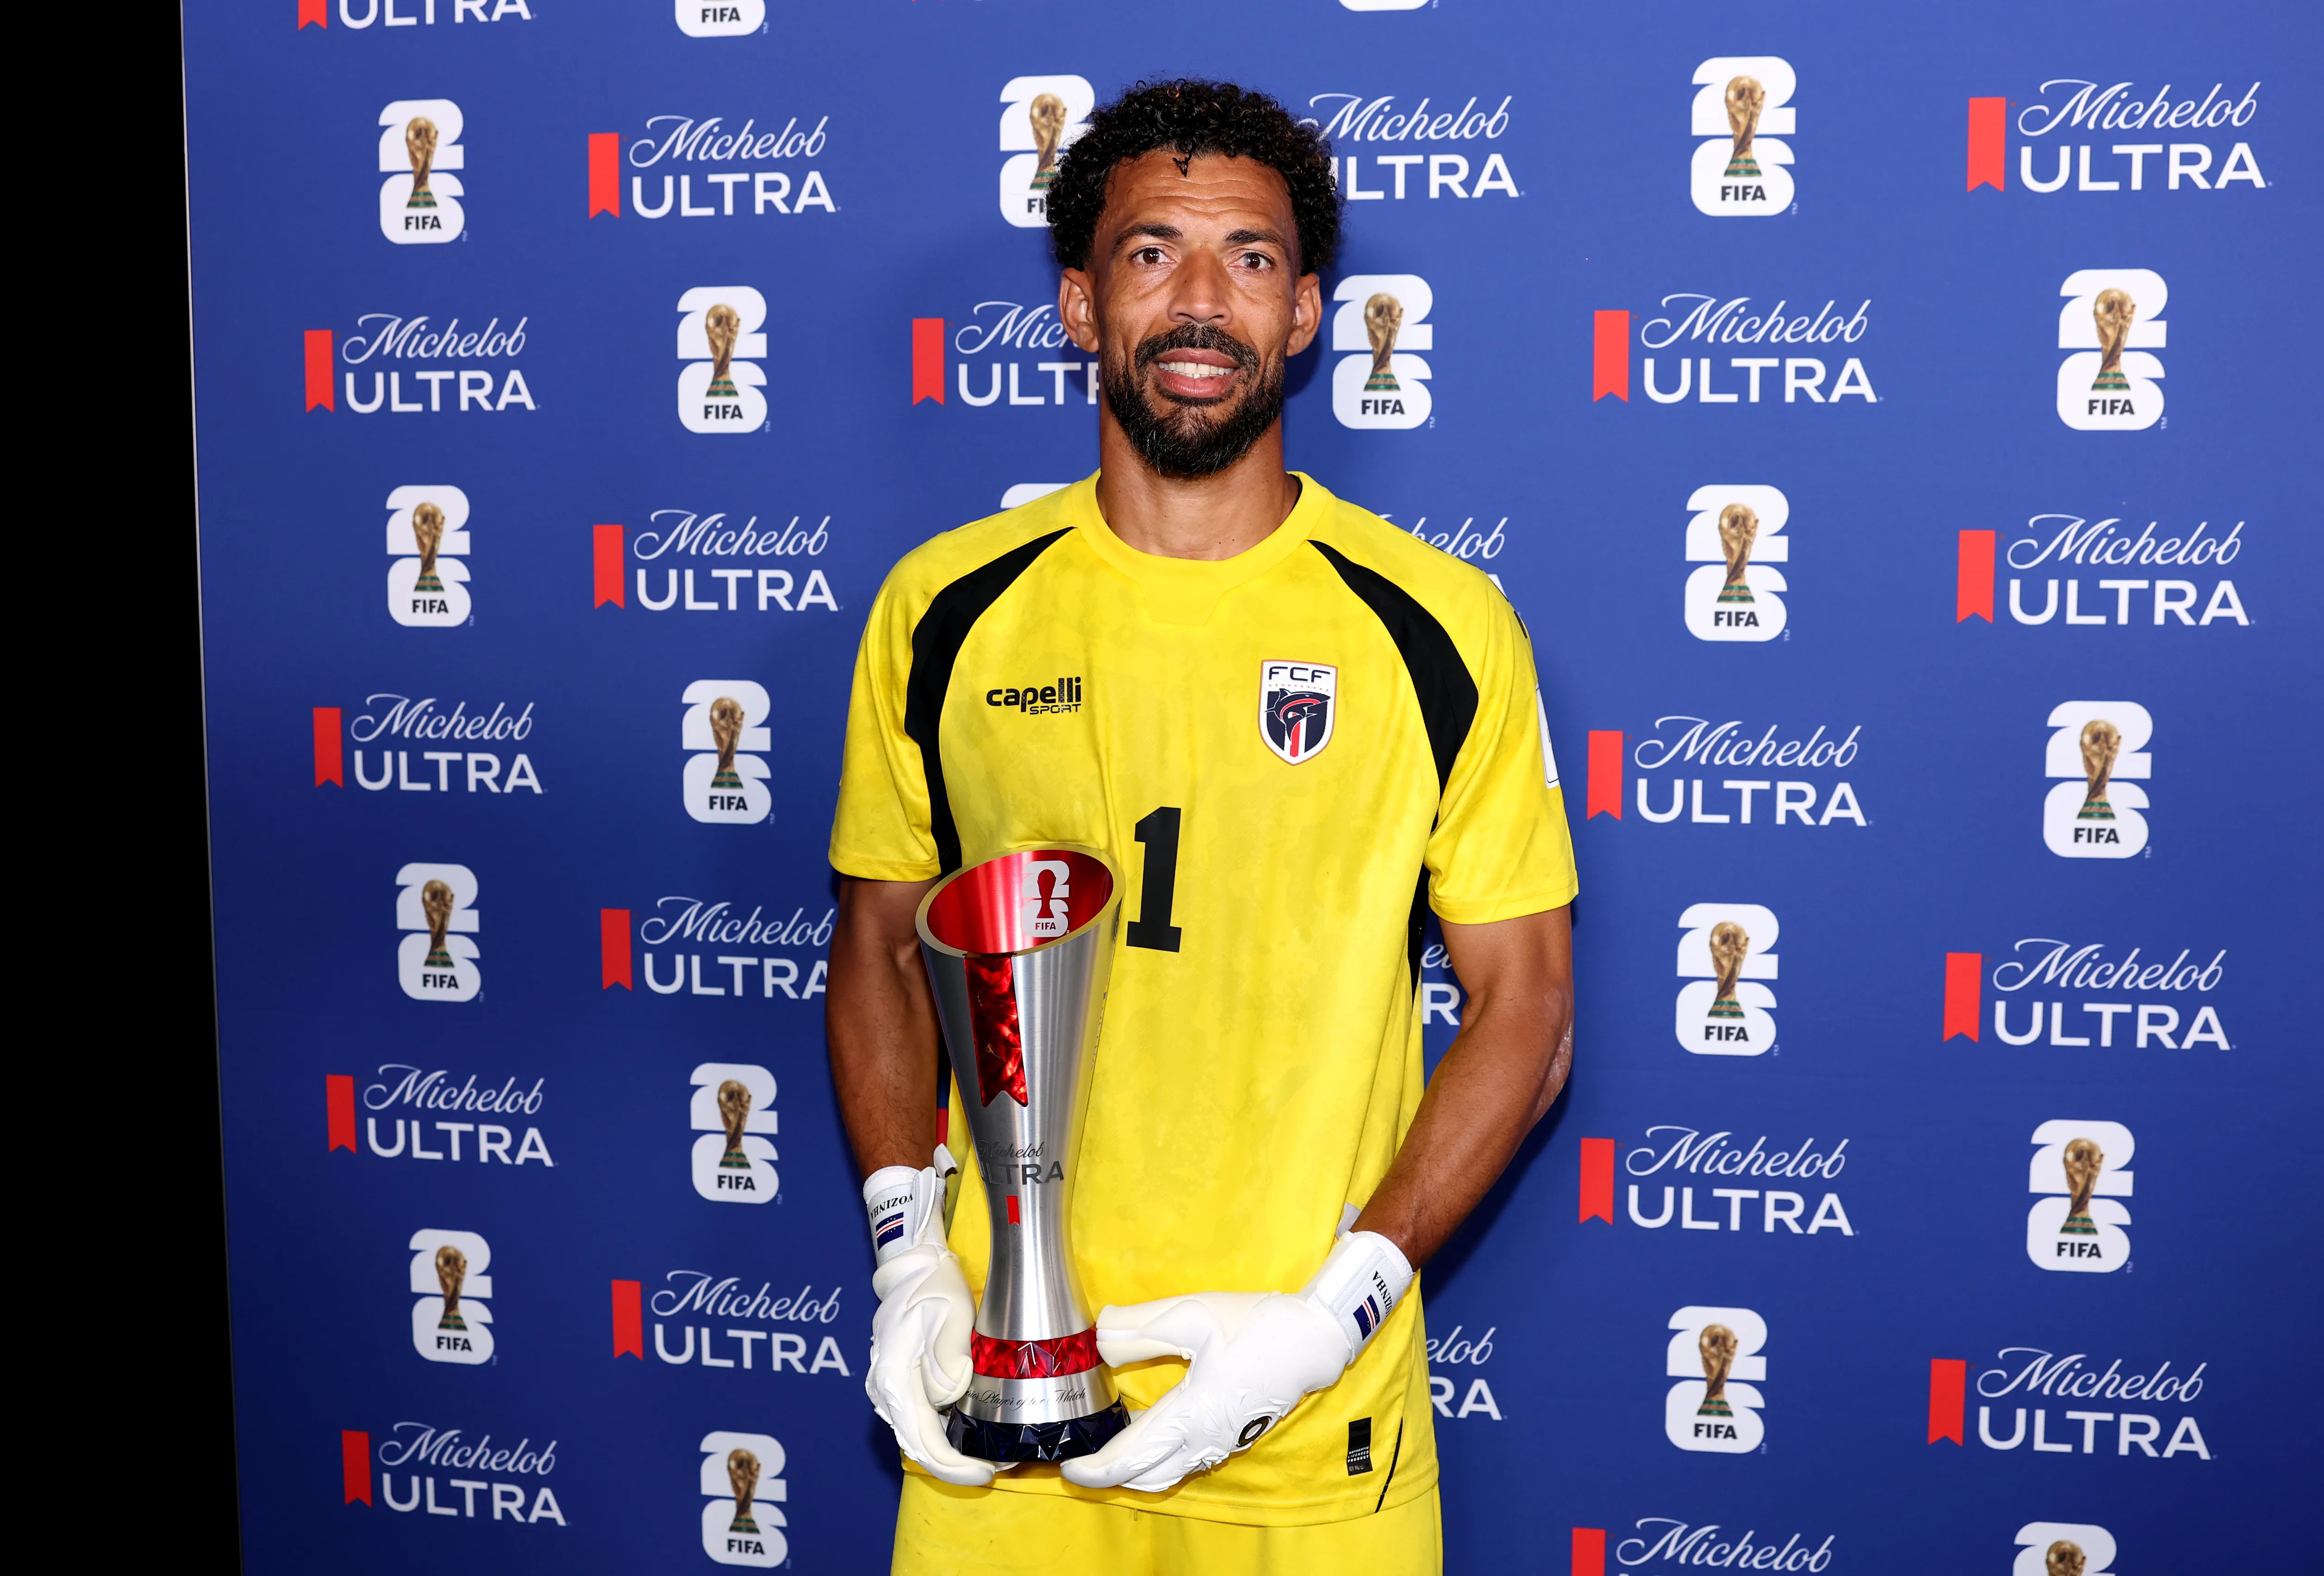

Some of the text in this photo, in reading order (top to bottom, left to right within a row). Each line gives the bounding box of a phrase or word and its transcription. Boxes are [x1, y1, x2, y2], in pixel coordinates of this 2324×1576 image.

[702, 7, 740, 23] FIFA
[1297, 93, 1512, 142] Michelob
[2018, 80, 2260, 136] Michelob
[629, 116, 828, 168] Michelob
[1329, 154, 1519, 200] LTRA
[2021, 143, 2266, 192] ULTRA
[633, 171, 836, 218] ULTRA
[1028, 198, 1044, 213] FI
[1721, 185, 1766, 201] FIFA
[405, 216, 441, 230] FIFA
[343, 314, 528, 364] Michelob
[1641, 294, 1870, 348] Michelob
[346, 370, 535, 413] ULTRA
[1644, 358, 1877, 403] ULTRA
[704, 405, 743, 419] FIFA
[1361, 399, 1405, 416] FIFA
[2088, 399, 2135, 415] FIFA
[634, 510, 830, 559] Michelob
[2007, 514, 2244, 569] Michelob
[412, 599, 448, 613] FIFA
[637, 569, 838, 611] ULTRA
[2009, 579, 2249, 626] ULTRA
[1714, 611, 1759, 627] FIFA
[986, 676, 1081, 713] capelli
[1268, 666, 1330, 683] FCF
[352, 694, 534, 741] Michelob
[1030, 704, 1081, 715] SPORT
[1635, 716, 1861, 769] Michelob
[354, 751, 542, 794] ULTRA
[709, 795, 748, 811] FIFA
[1637, 778, 1866, 826] ULTRA
[2074, 827, 2119, 844] FIFA
[1126, 807, 1182, 953] 1
[641, 897, 834, 946] Michelob
[1035, 922, 1057, 931] FIFA
[423, 974, 459, 989] FIFA
[1993, 939, 2226, 991] Michelob
[1705, 1025, 1749, 1042] FIFA
[1995, 1001, 2230, 1050] ULTRA
[364, 1065, 544, 1114] Michelob
[367, 1118, 553, 1166] ULTRA
[1626, 1126, 1849, 1178] Michelob
[717, 1175, 756, 1191] FIFA
[870, 1193, 913, 1221] VOZINHA
[1628, 1185, 1853, 1235] ULTRA
[2057, 1242, 2102, 1259] FIFA
[651, 1271, 841, 1323] Michelob
[1373, 1270, 1392, 1318] OZINHA
[436, 1336, 472, 1352] FIFA
[655, 1324, 850, 1376] ULTRA
[1977, 1347, 2206, 1402] Michelob
[979, 1390, 1015, 1409] Player
[1047, 1387, 1087, 1406] Match
[380, 1422, 557, 1475] Michelob
[1348, 1446, 1369, 1454] AUTHENTIC
[1694, 1423, 1737, 1439] FIFA
[1979, 1406, 2210, 1459] ULTRA
[1348, 1450, 1369, 1458] LICENSED
[383, 1473, 566, 1526] ULTRA
[727, 1539, 764, 1555] FIFA
[1616, 1518, 1834, 1572] Michelob
